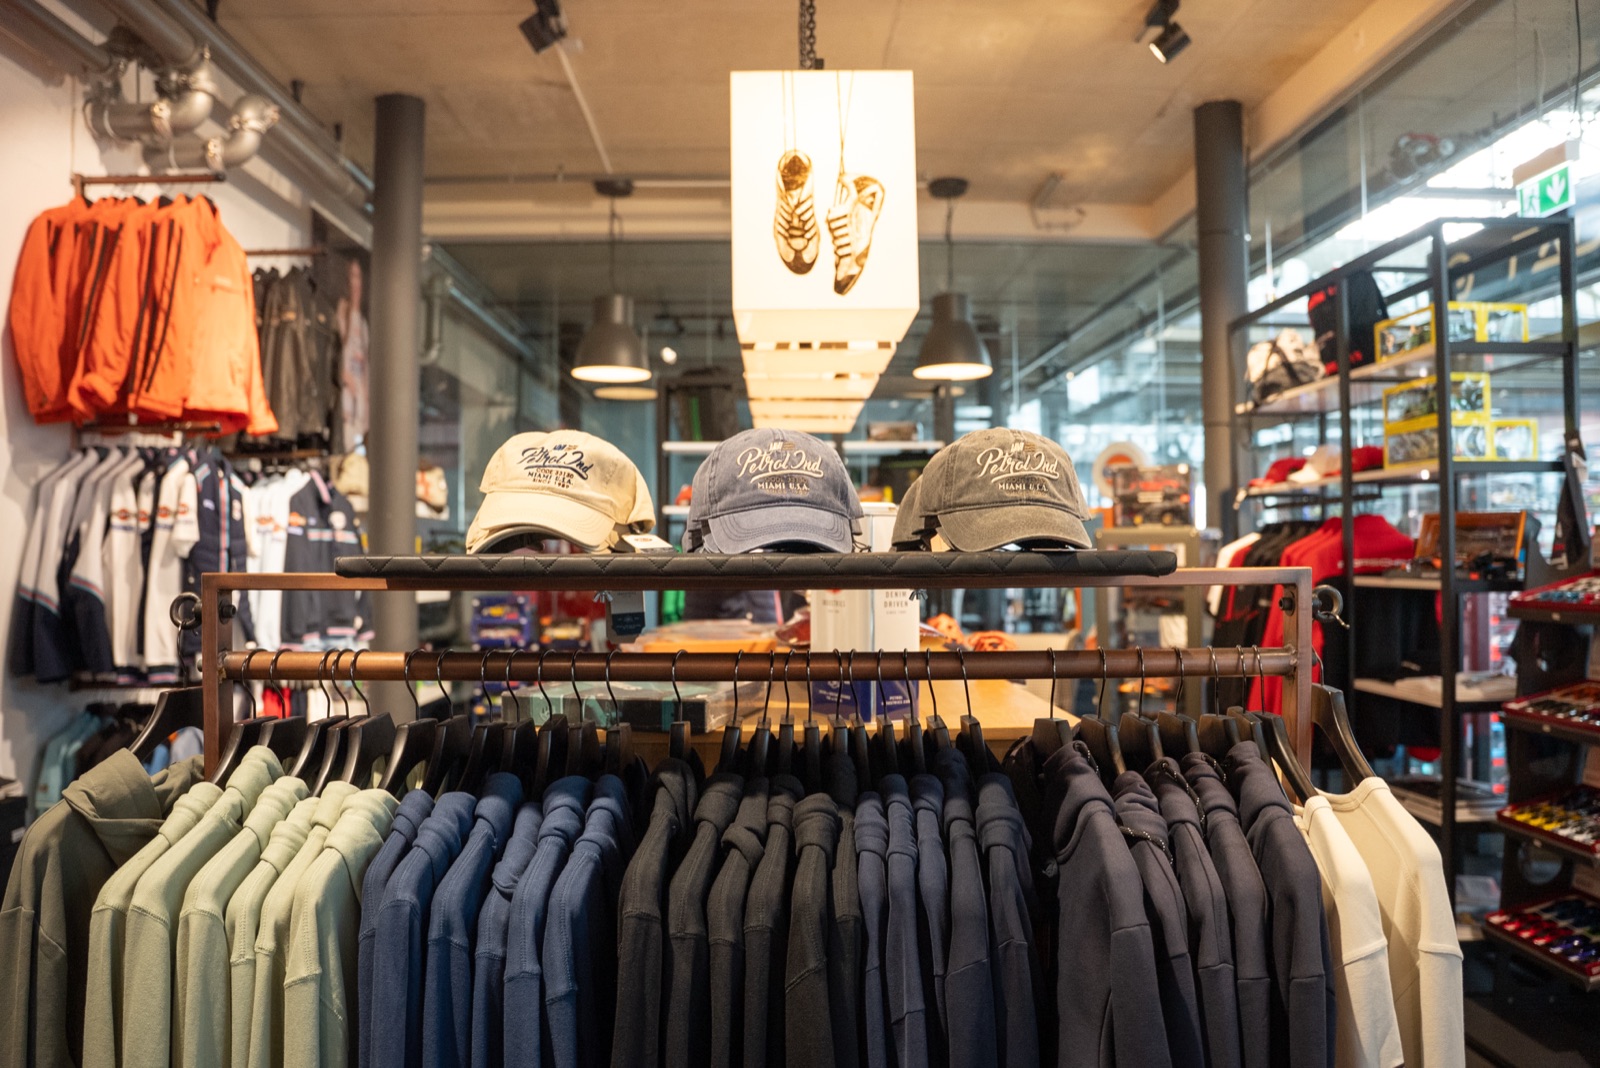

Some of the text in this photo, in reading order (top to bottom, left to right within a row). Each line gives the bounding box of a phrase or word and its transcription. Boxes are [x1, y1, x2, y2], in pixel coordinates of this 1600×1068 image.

[517, 447, 594, 473] Petrol Ind
[737, 447, 822, 478] Petrol Ind
[976, 448, 1058, 478] Petrol Ind
[527, 471, 552, 480] MIAMI
[757, 482, 810, 491] MIAMI U.S.A.
[998, 483, 1049, 492] MIAMI U.S.A.
[885, 590, 907, 599] DENIM
[883, 600, 909, 609] DRIVEN
